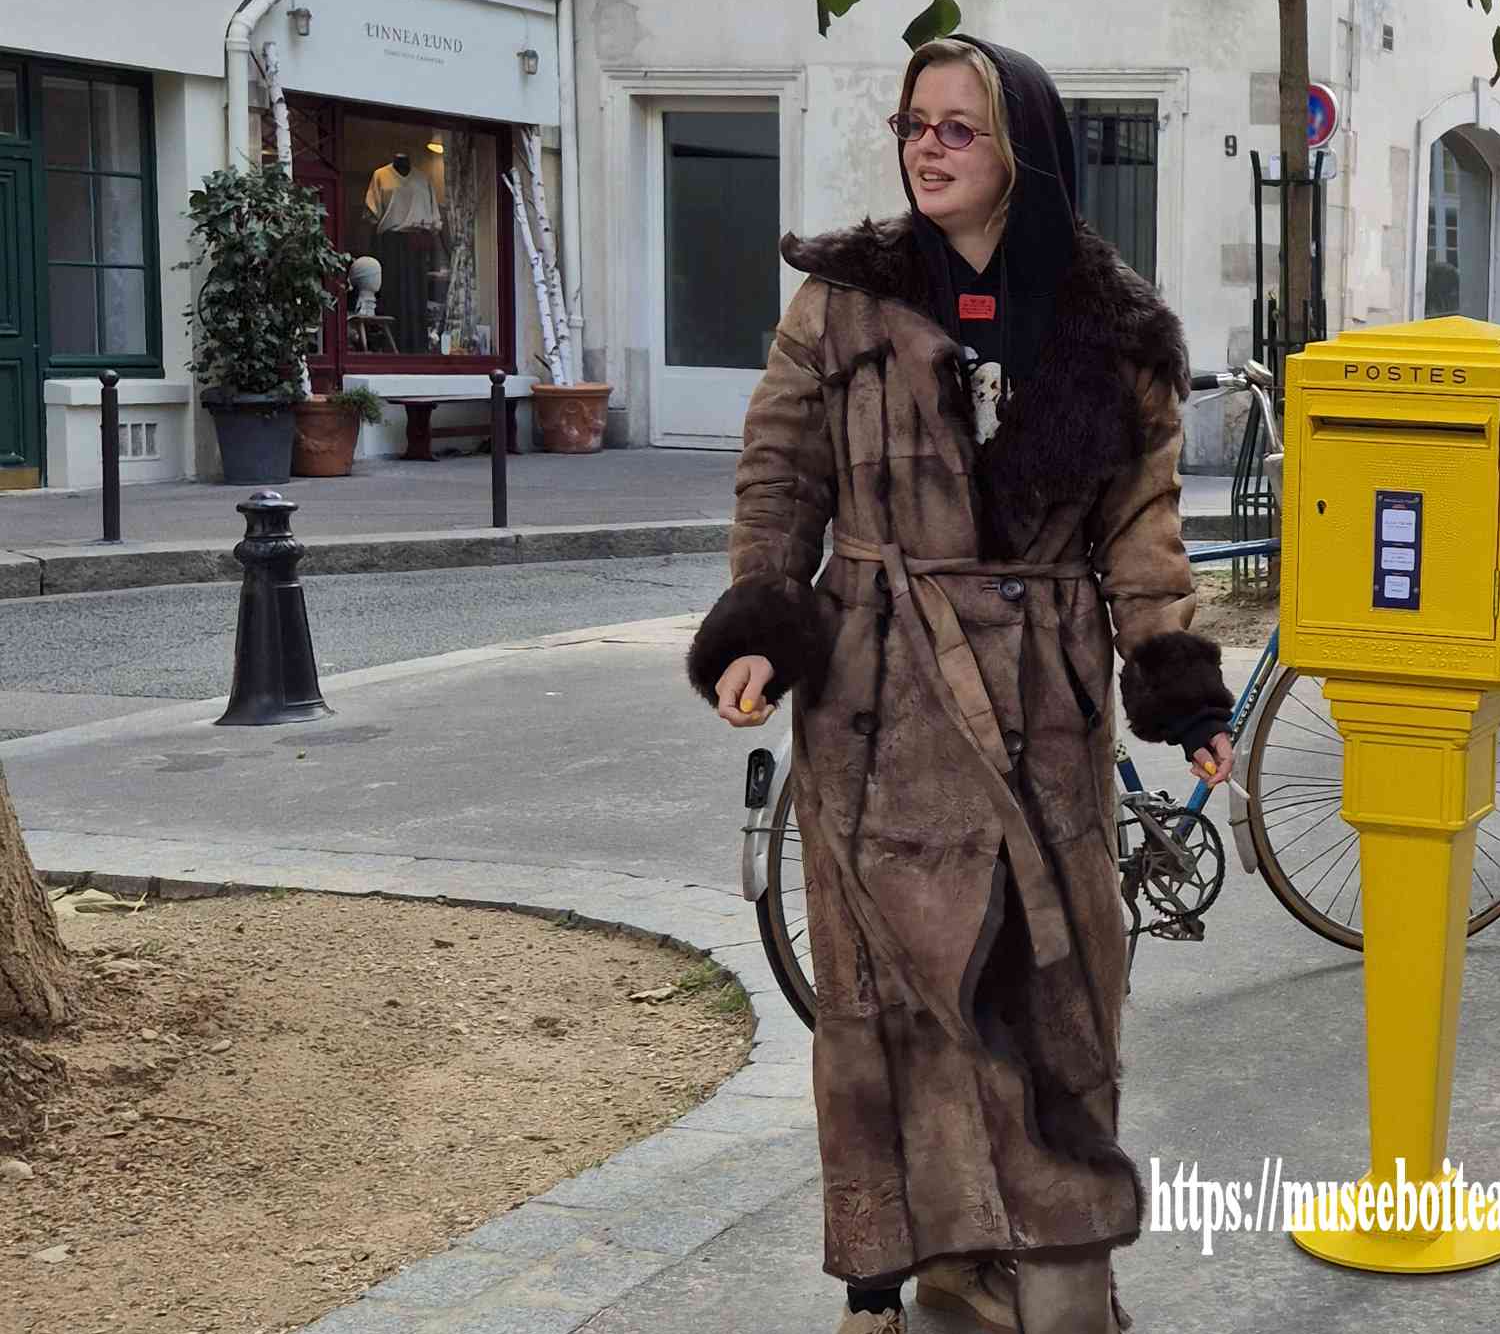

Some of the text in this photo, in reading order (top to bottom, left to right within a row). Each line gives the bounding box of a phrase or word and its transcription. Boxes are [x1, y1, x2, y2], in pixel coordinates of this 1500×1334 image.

[365, 22, 464, 53] LINNEA LUND
[1224, 134, 1237, 157] 9
[1344, 364, 1467, 384] POSTES
